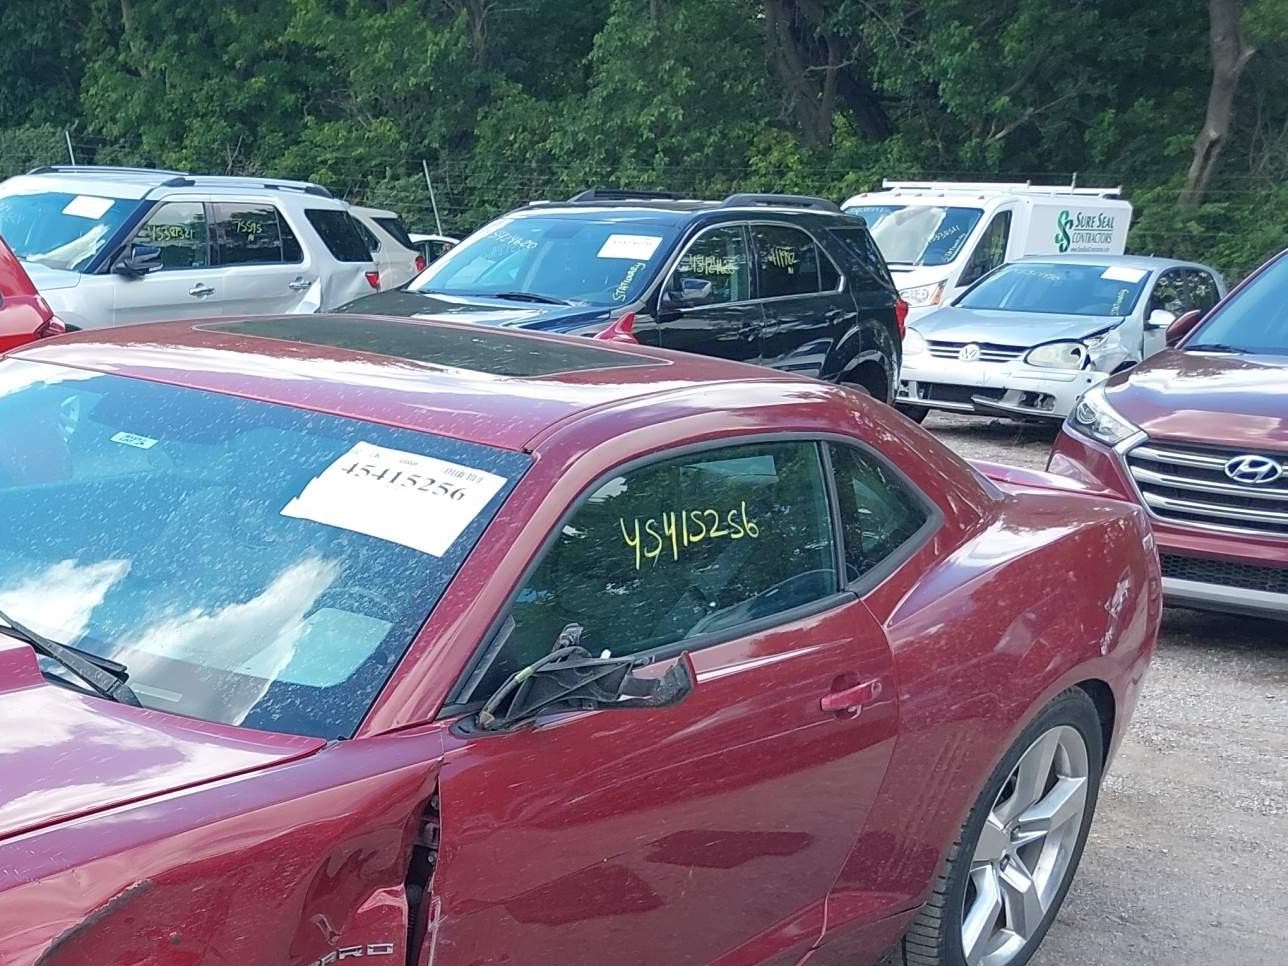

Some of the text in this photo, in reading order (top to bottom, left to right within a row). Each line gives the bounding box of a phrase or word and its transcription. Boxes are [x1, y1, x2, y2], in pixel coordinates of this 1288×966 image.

[1075, 211, 1114, 229] SURE SEAL
[1072, 232, 1112, 244] CONTRACTORS
[341, 461, 467, 502] 45415256
[620, 501, 760, 571] 45415256
